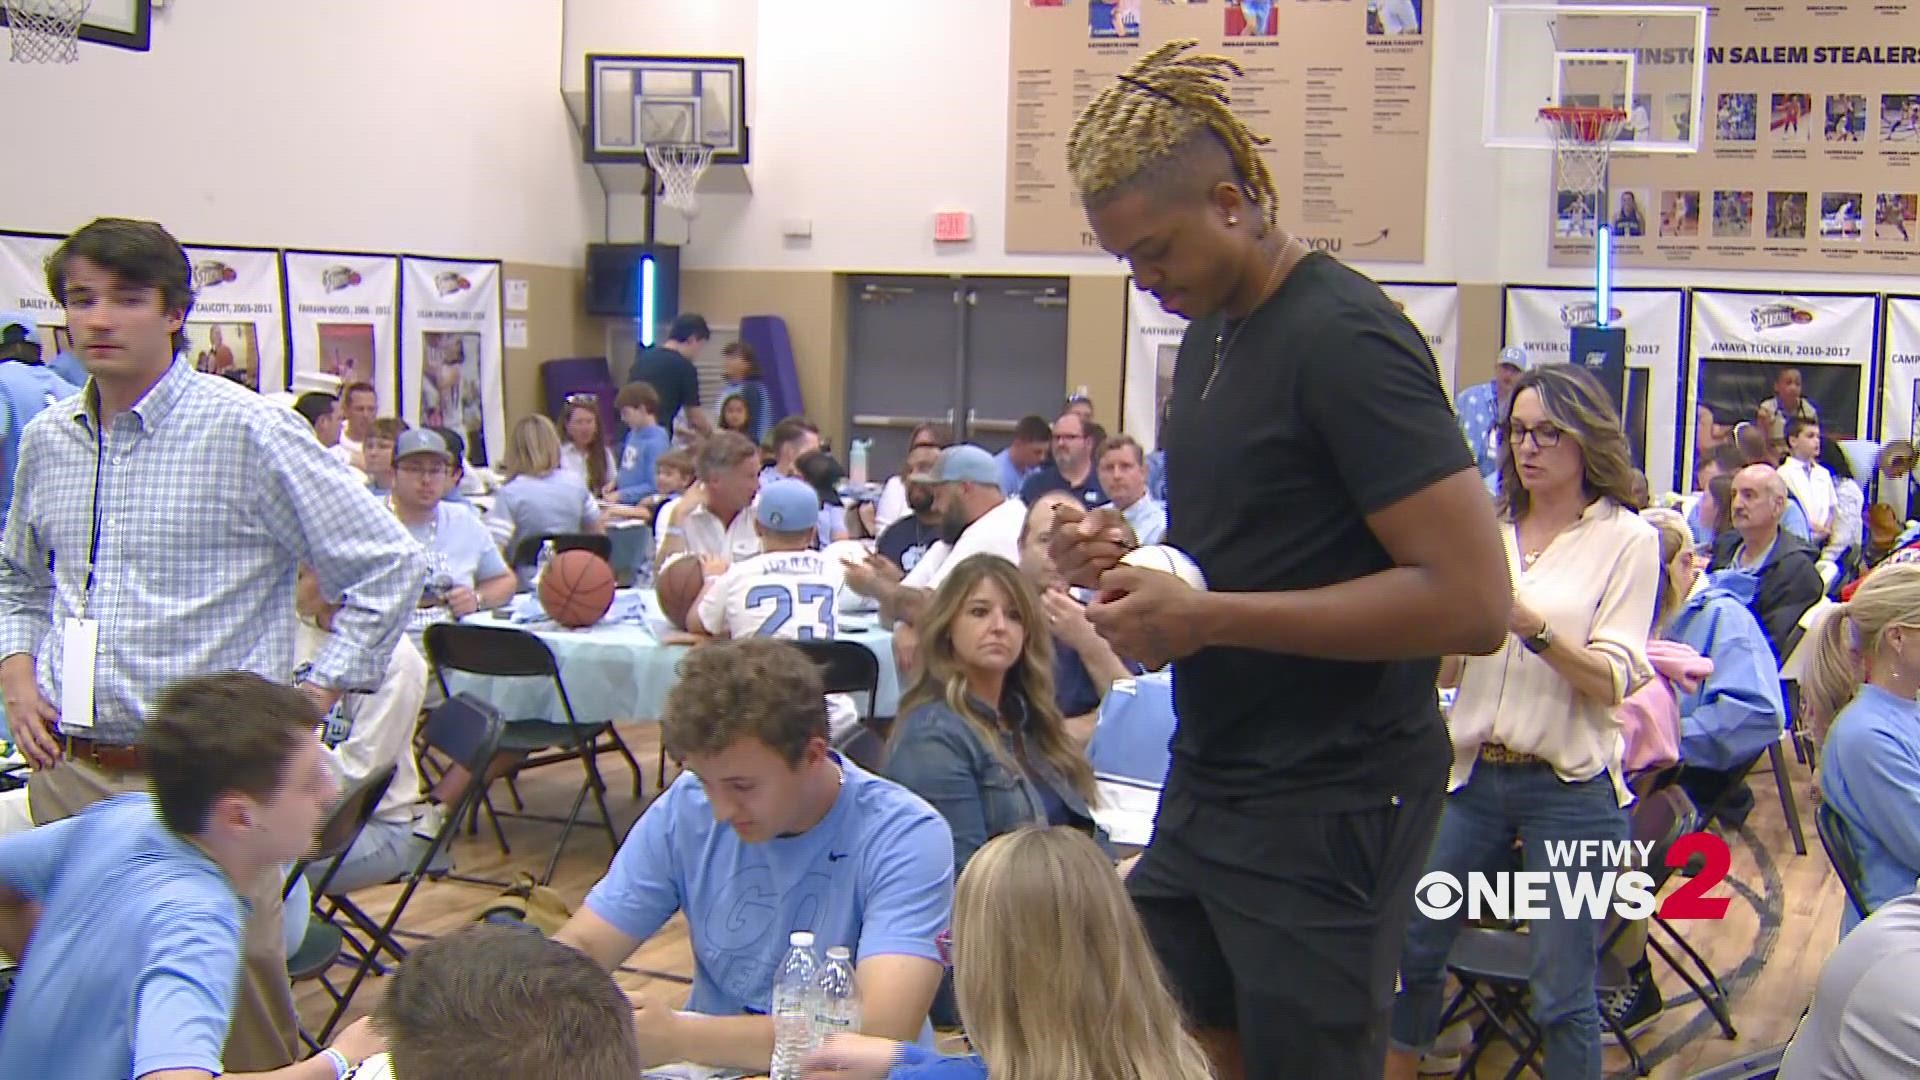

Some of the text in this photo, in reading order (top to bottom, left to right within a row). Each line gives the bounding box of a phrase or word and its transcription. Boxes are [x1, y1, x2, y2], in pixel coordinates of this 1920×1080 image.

[1729, 46, 1808, 64] SALEM
[1812, 46, 1920, 64] STEALER
[1307, 237, 1342, 253] YOU
[19, 298, 47, 309] BAILEY
[1140, 326, 1185, 336] KATHERY
[1625, 345, 1660, 355] 0-2017
[1711, 342, 1851, 357] AMAYA TUCKER, 2010-2017
[744, 584, 835, 641] 23
